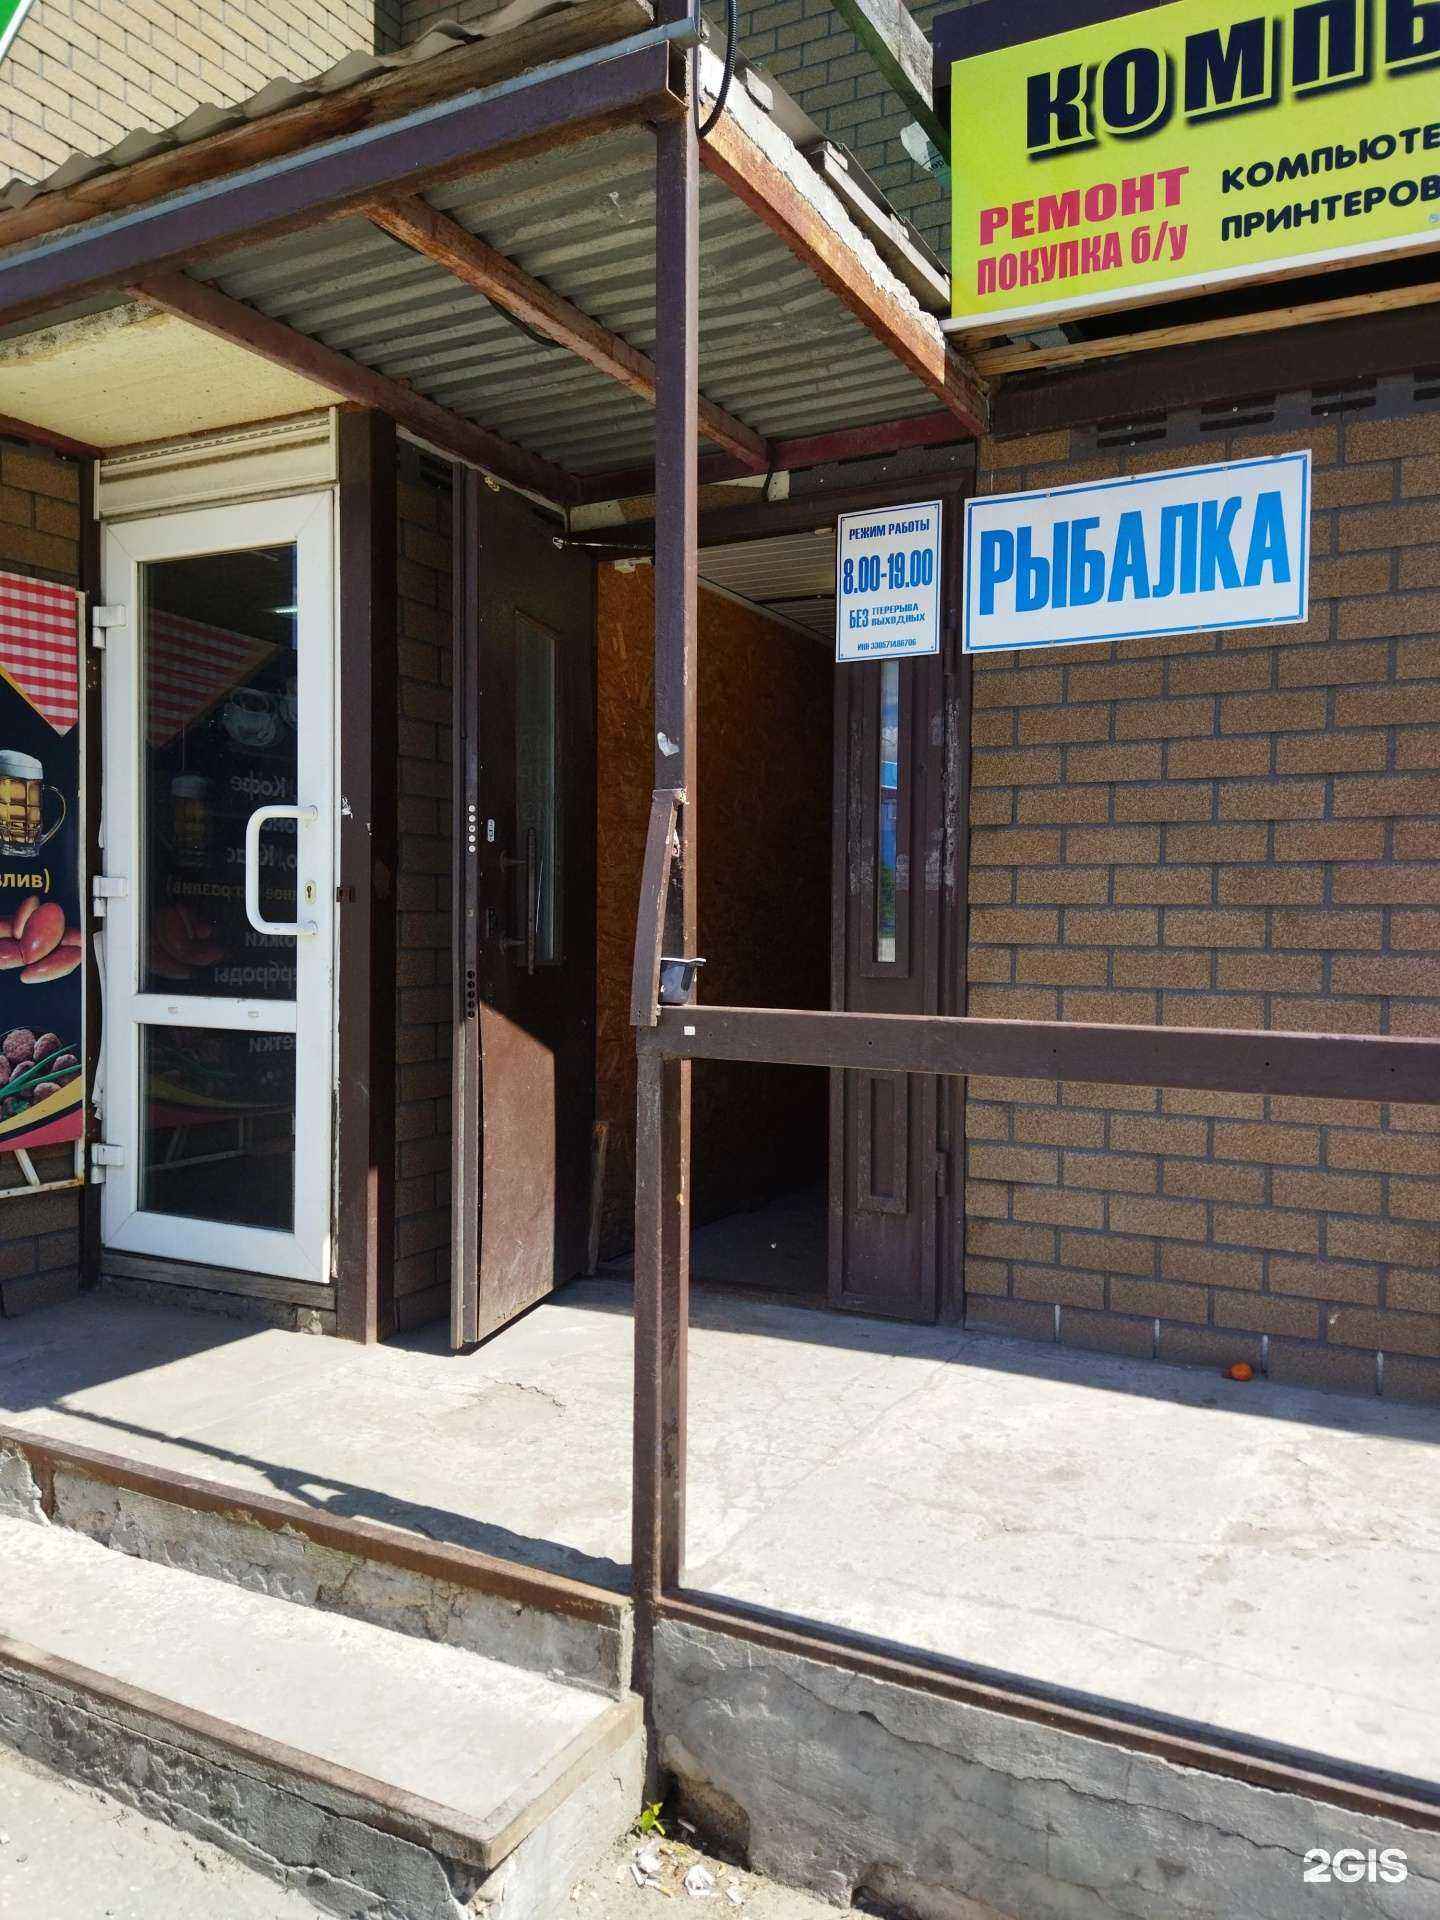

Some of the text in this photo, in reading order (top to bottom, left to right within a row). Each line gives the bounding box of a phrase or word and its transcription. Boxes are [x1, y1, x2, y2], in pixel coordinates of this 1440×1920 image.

[979, 166, 1190, 246] РЕМОНТ
[1221, 174, 1440, 242] ПРИНТЕРОВ
[976, 221, 1189, 296] ПОКУПКА б/у
[848, 518, 931, 541] РЕЖИМ РАБОТЫ
[978, 490, 1292, 616] РЫБАЛКА
[843, 548, 934, 595] 8.00-19.00
[849, 602, 919, 629] БЕЗ ПЕРЕРЫВА
[871, 612, 926, 627] ВЫХОДНЫХ
